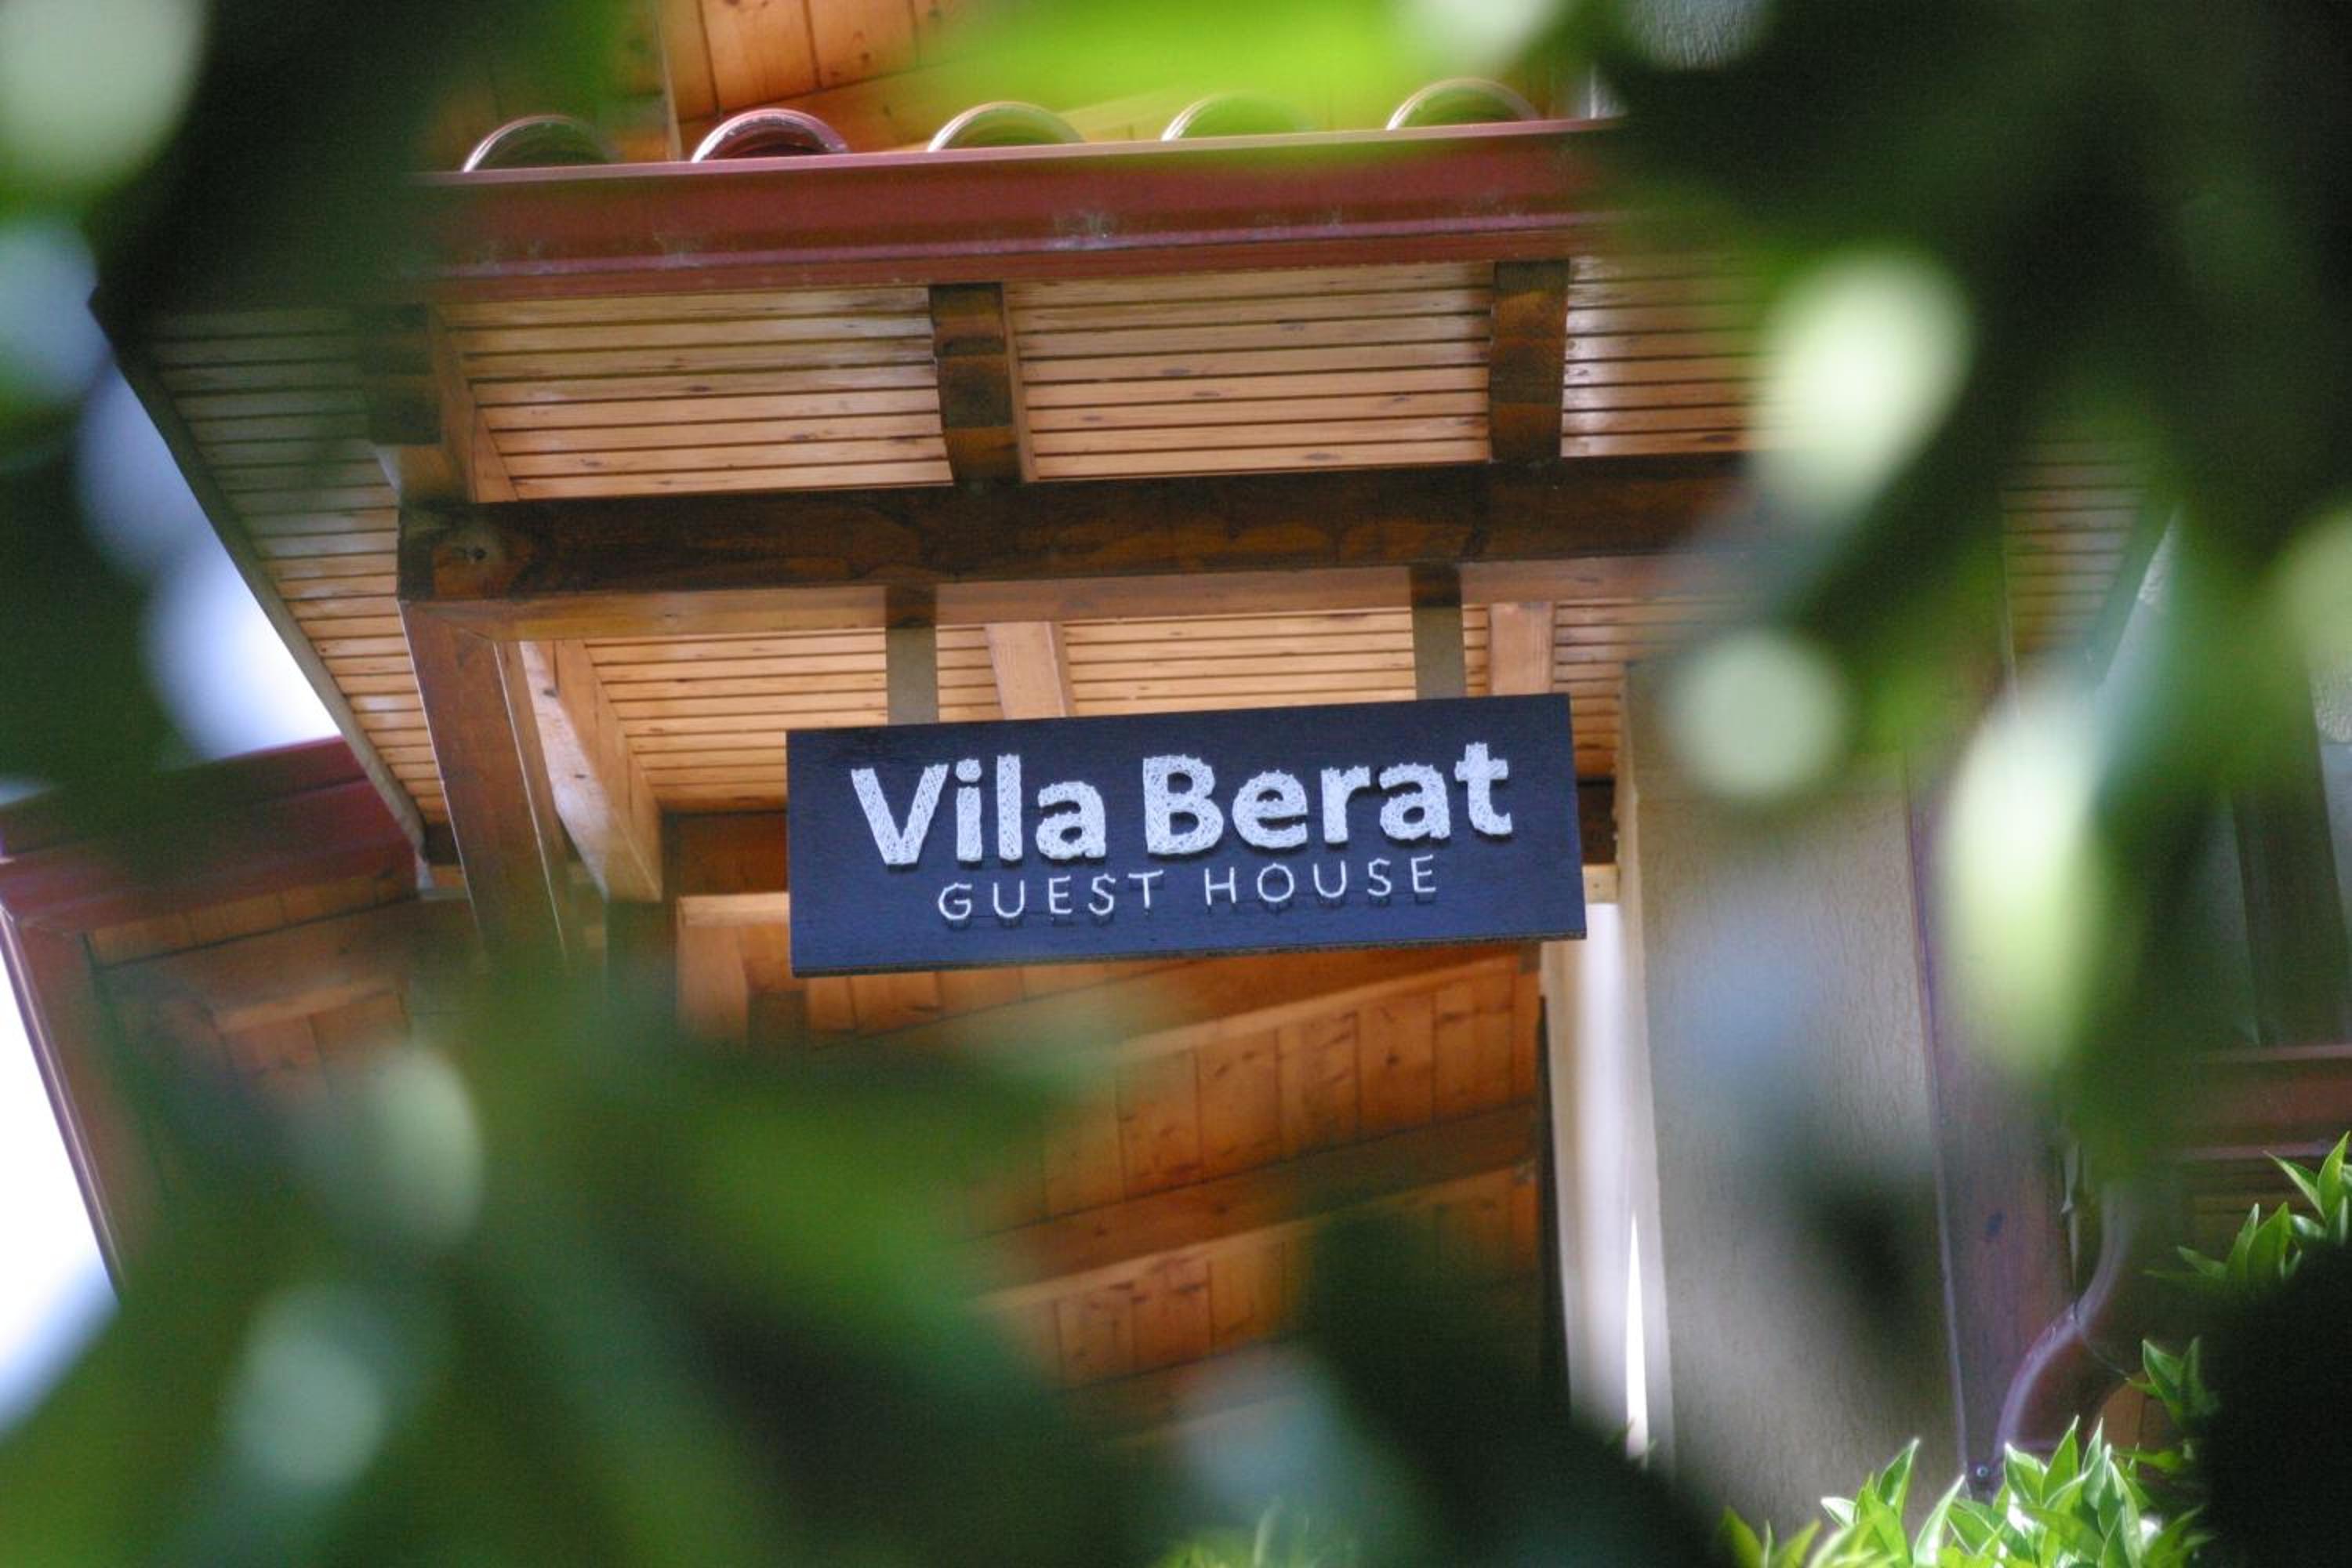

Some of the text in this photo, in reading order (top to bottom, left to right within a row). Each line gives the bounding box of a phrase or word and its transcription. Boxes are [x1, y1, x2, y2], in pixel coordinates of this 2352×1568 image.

[850, 742, 1514, 866] Vila Berat
[937, 854, 1437, 921] GUEST HOUSE
